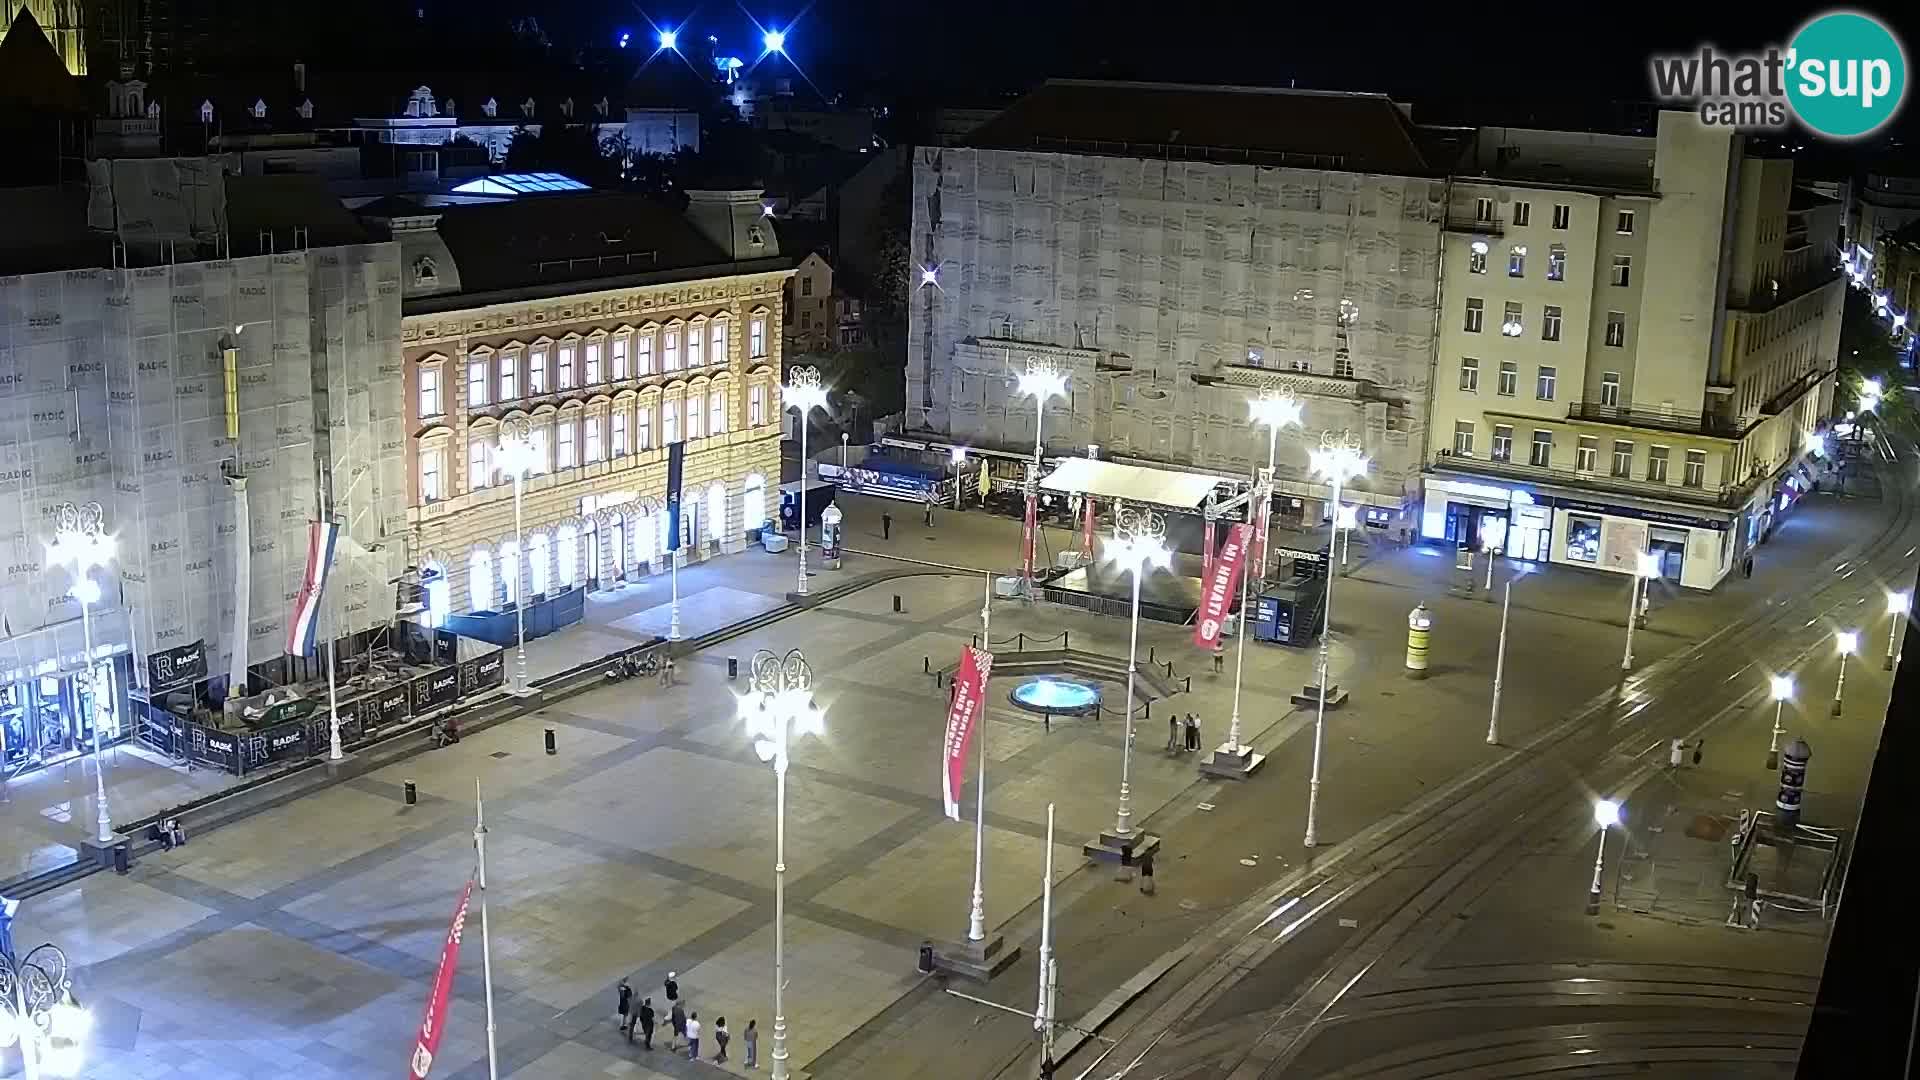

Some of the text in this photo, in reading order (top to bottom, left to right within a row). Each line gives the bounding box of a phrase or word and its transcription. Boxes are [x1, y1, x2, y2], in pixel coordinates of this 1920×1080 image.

[1208, 543, 1240, 616] MI HRVATI
[956, 680, 970, 711] FANS
